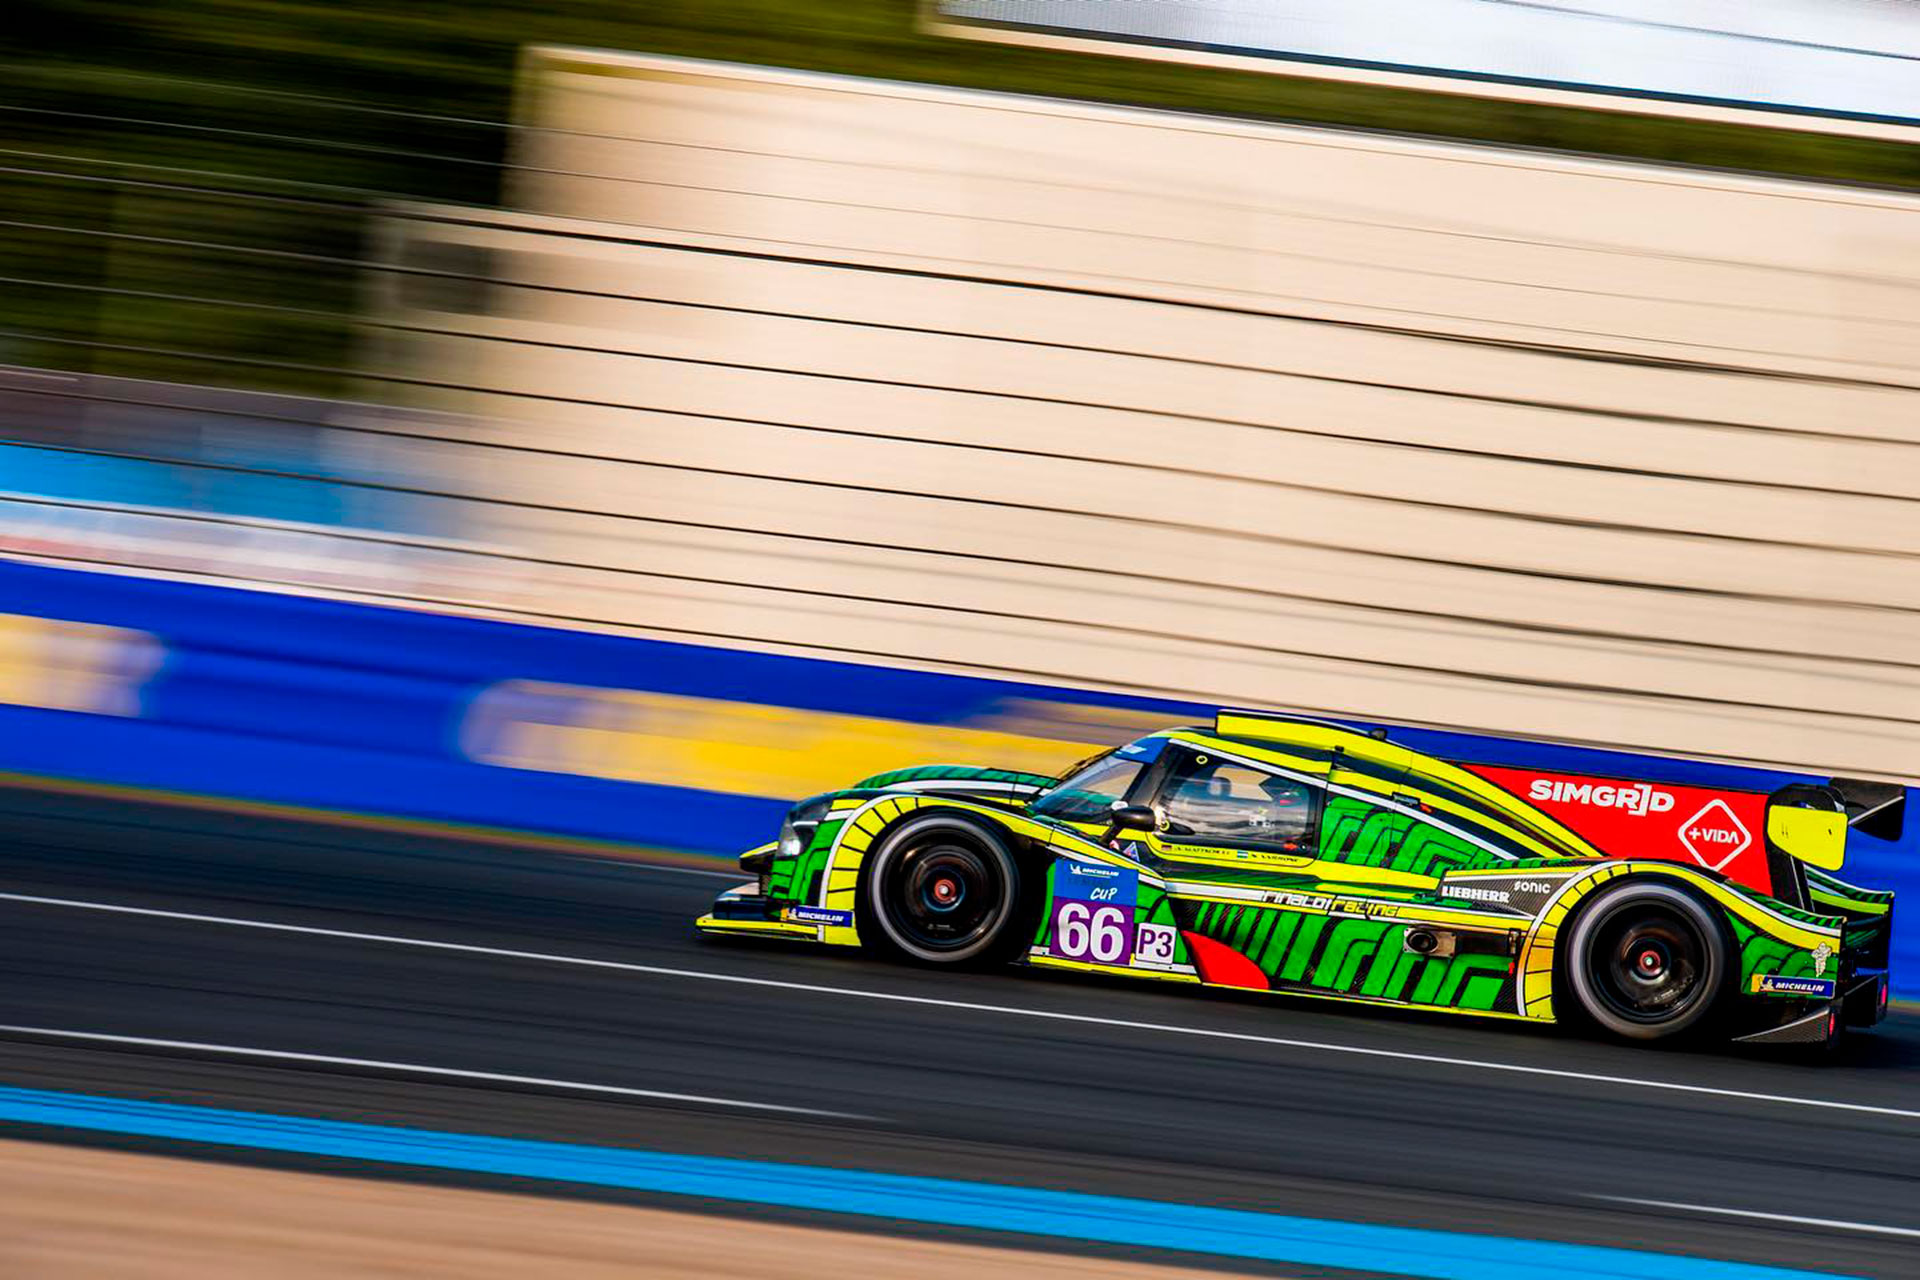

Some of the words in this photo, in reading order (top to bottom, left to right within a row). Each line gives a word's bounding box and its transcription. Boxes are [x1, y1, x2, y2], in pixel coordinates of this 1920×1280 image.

[1528, 778, 1675, 817] SIMGRID
[1082, 867, 1120, 877] MICHELIN
[1089, 887, 1118, 901] CUP
[1441, 885, 1511, 903] LIEBHERR
[797, 911, 845, 922] MICHELIN
[1057, 902, 1125, 962] 66
[1138, 928, 1173, 958] P3
[1775, 982, 1825, 992] MICHELIN
